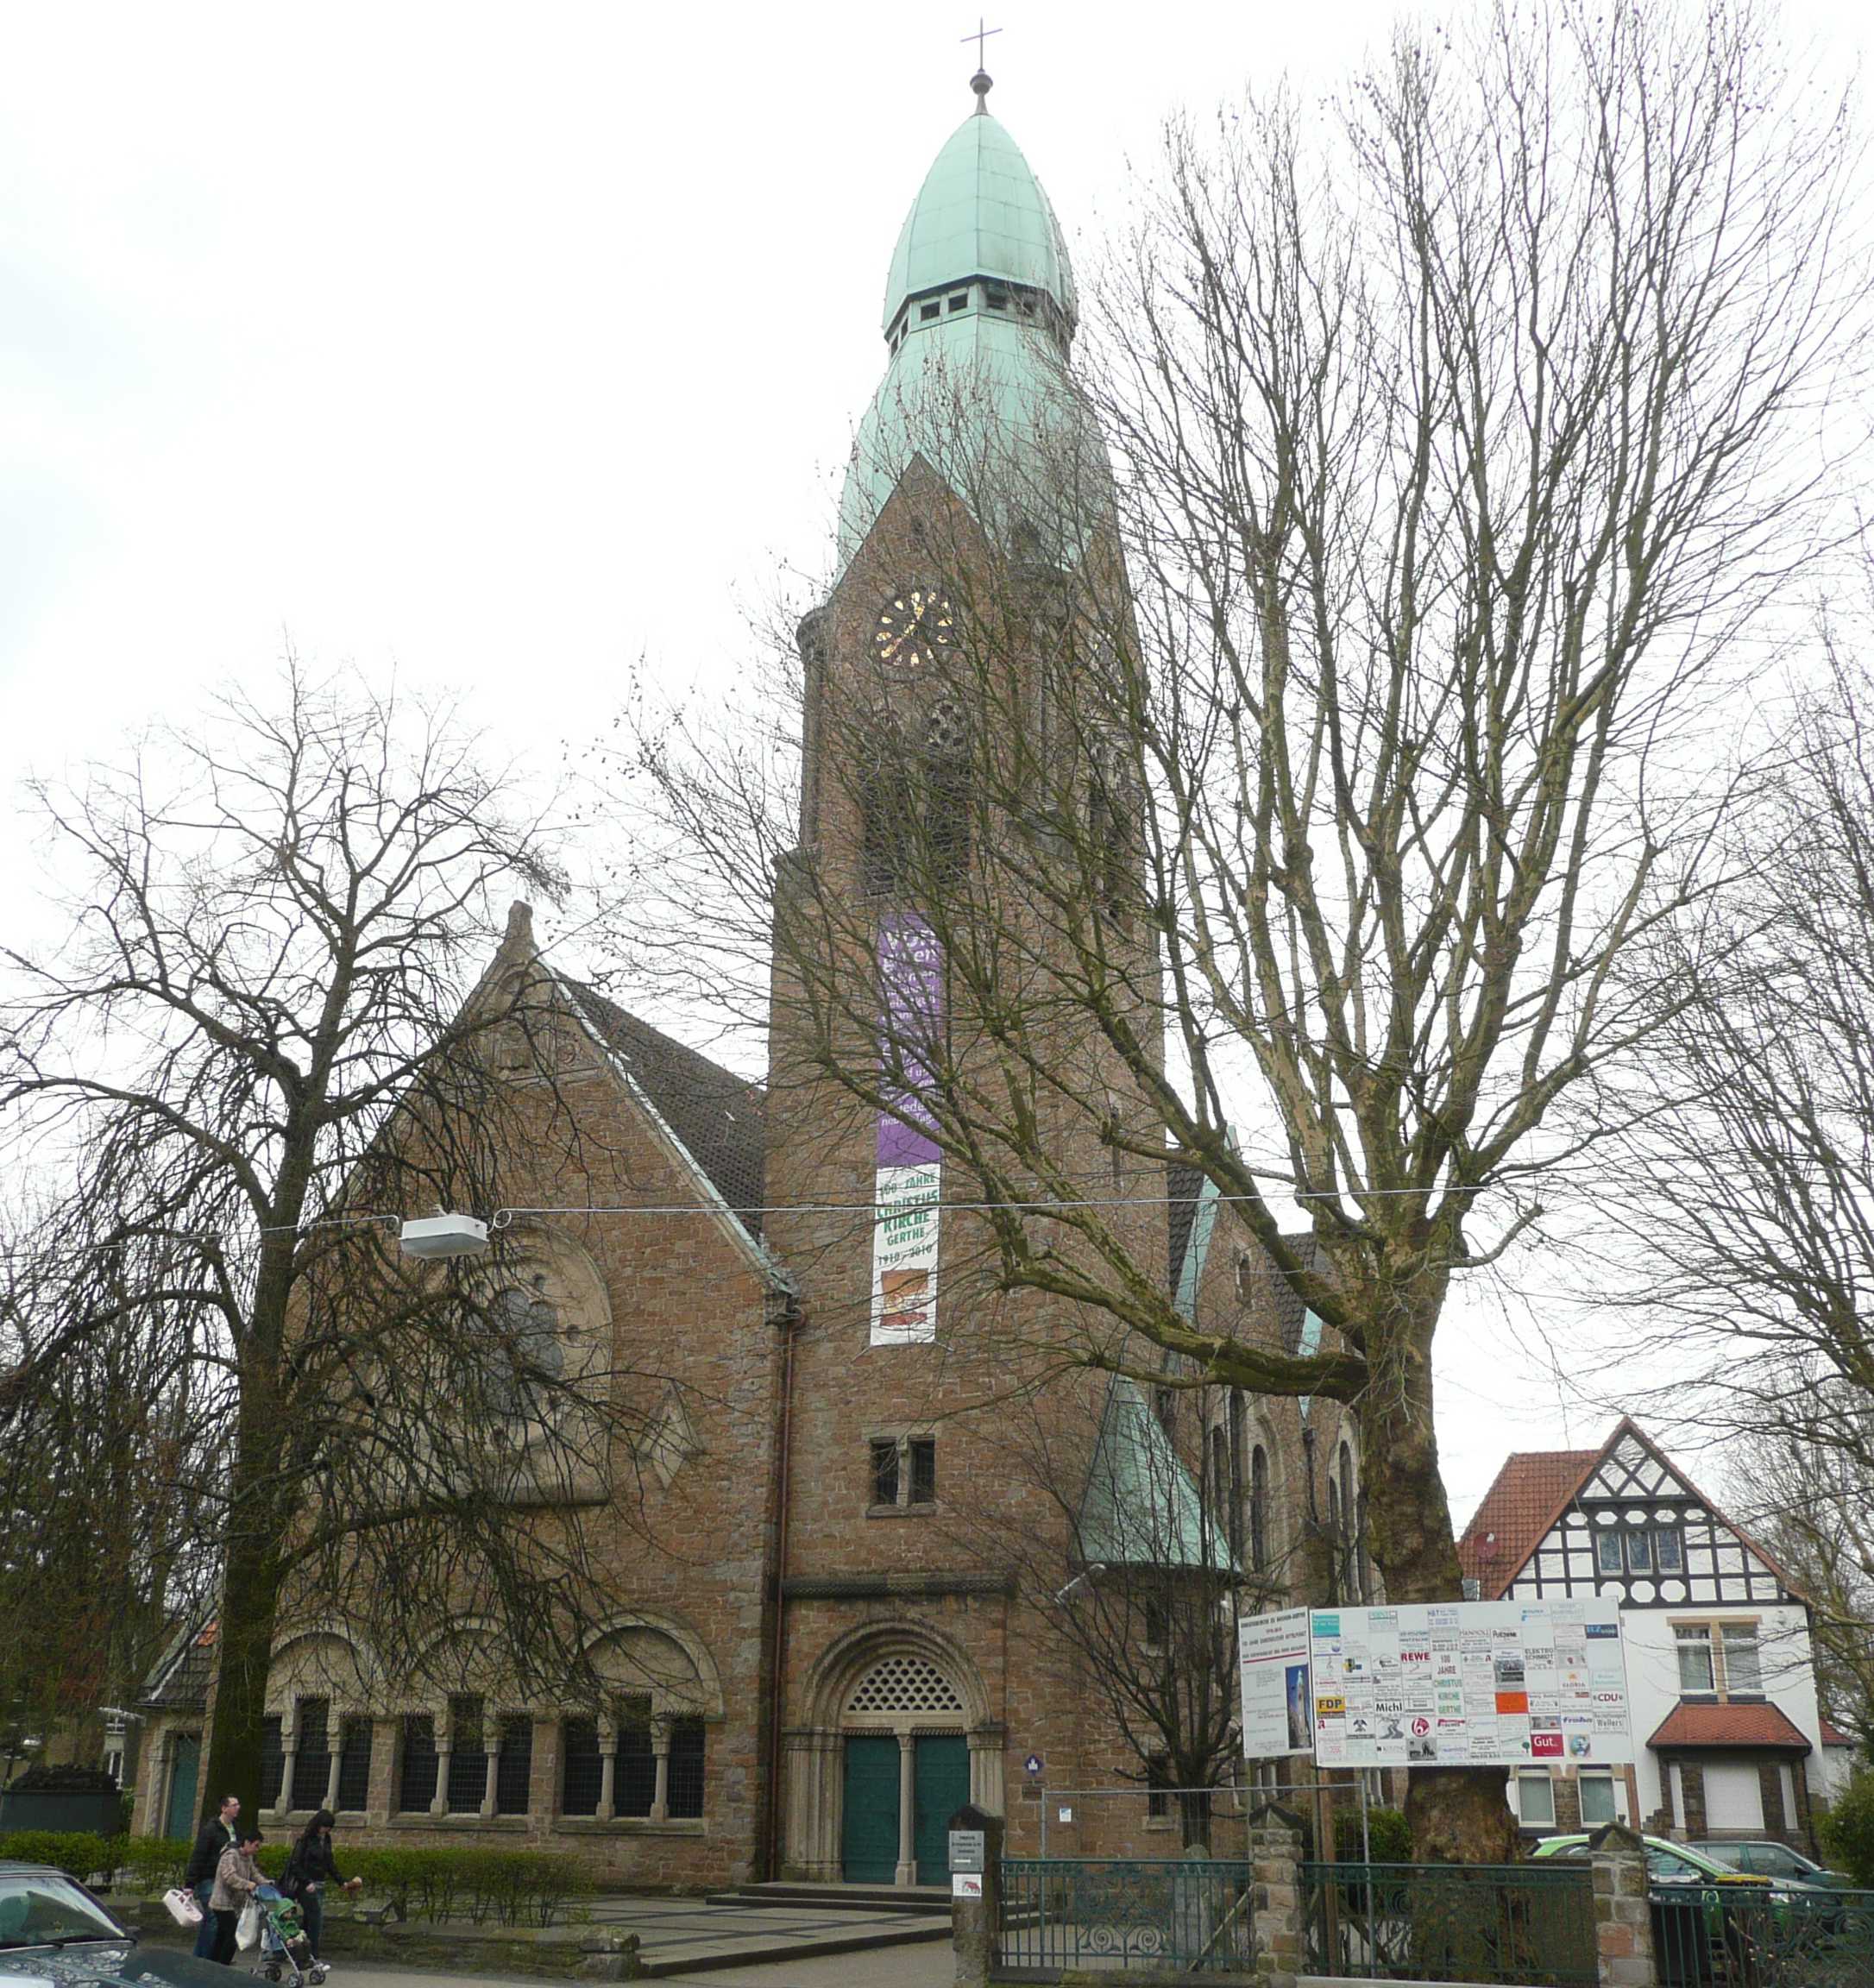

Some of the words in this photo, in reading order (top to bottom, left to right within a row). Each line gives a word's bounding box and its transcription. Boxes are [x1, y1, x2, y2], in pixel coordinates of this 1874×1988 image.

[905, 1174, 935, 1189] JAHRE
[884, 1211, 930, 1233] KIRCHE
[887, 1227, 925, 1246] GERTHE
[1401, 1652, 1431, 1662] REWE
[1598, 1693, 1619, 1702] CDU
[1318, 1699, 1343, 1709] FDP
[1375, 1702, 1403, 1712] Michl
